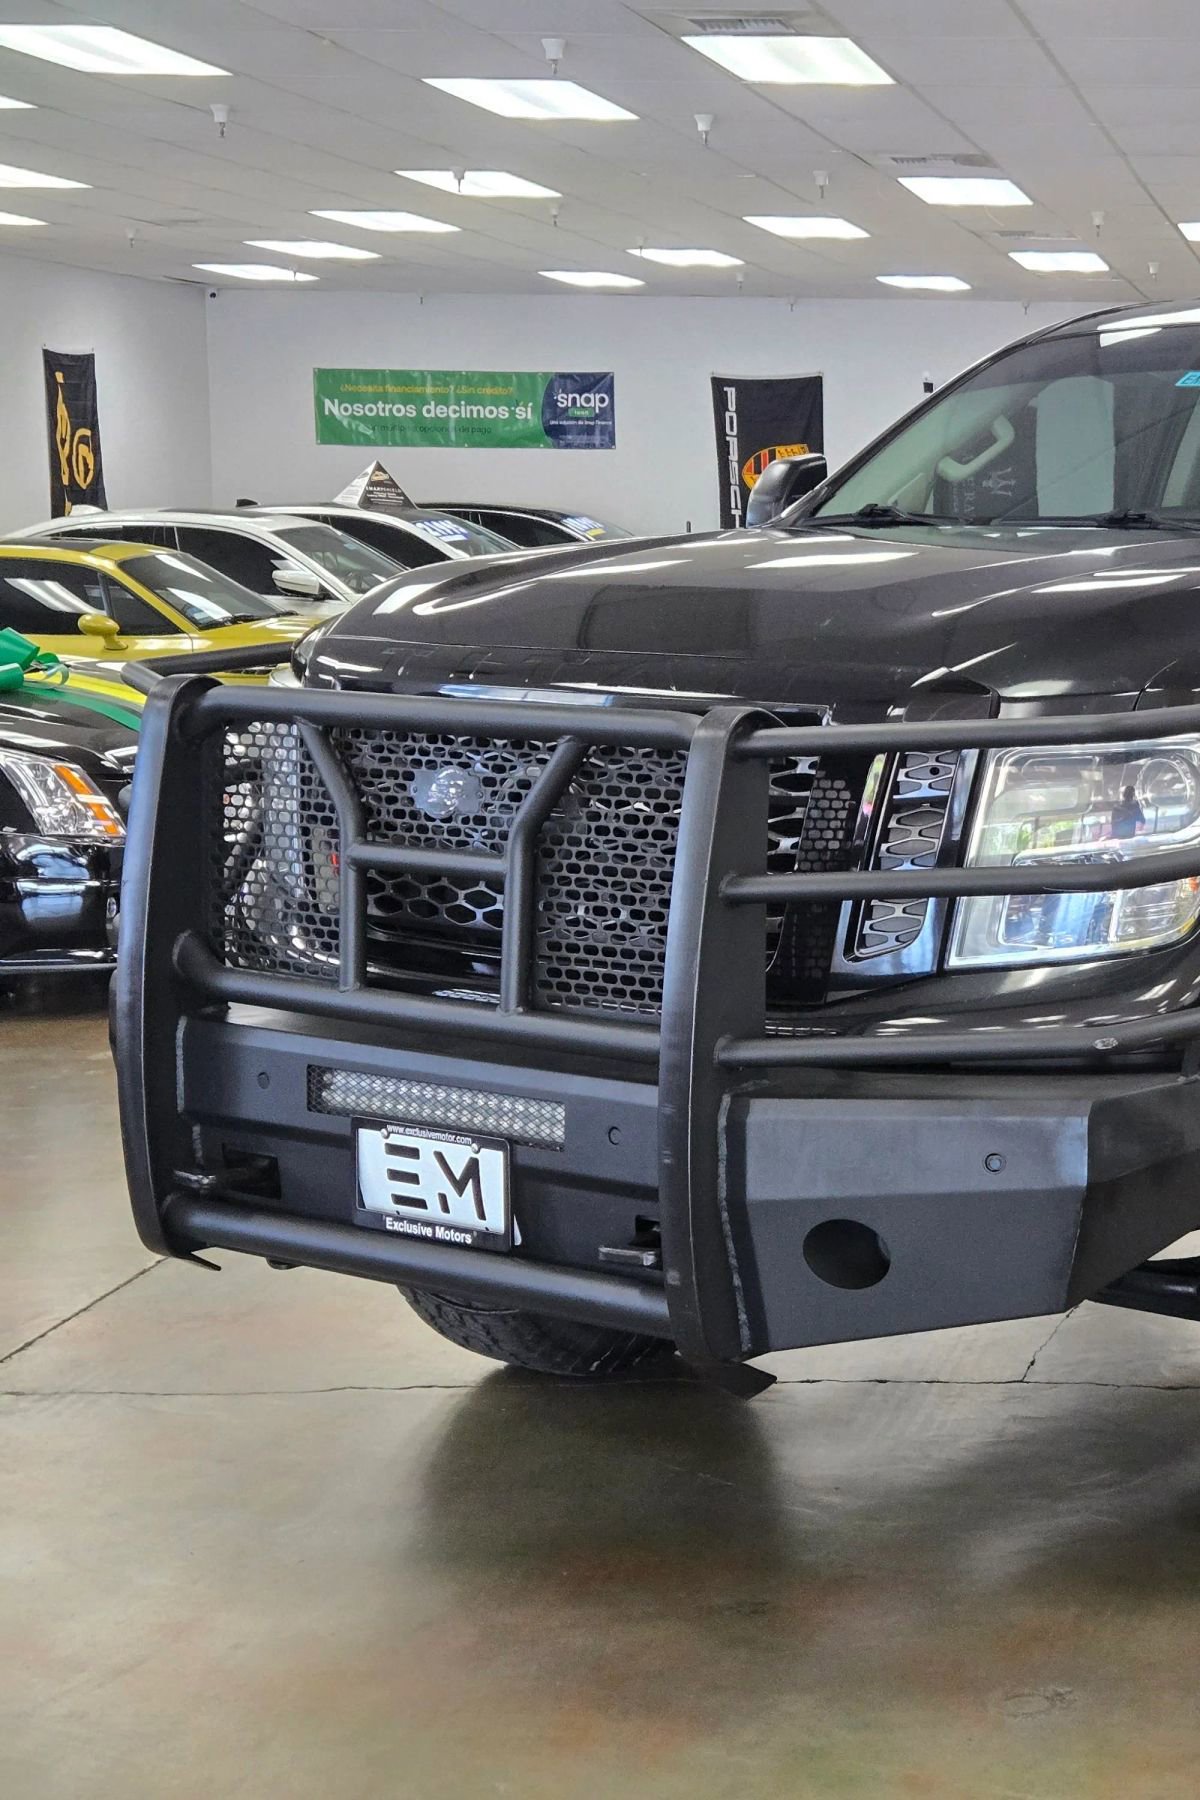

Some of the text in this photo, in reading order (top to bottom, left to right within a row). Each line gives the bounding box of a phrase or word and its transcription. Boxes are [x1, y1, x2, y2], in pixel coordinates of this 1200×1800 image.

[324, 398, 417, 418] Nosotros
[422, 401, 509, 419] decimos
[556, 392, 609, 414] snap
[386, 1124, 472, 1145] www.exclusivemotor.com
[385, 1217, 472, 1244] Exclusive Motors
